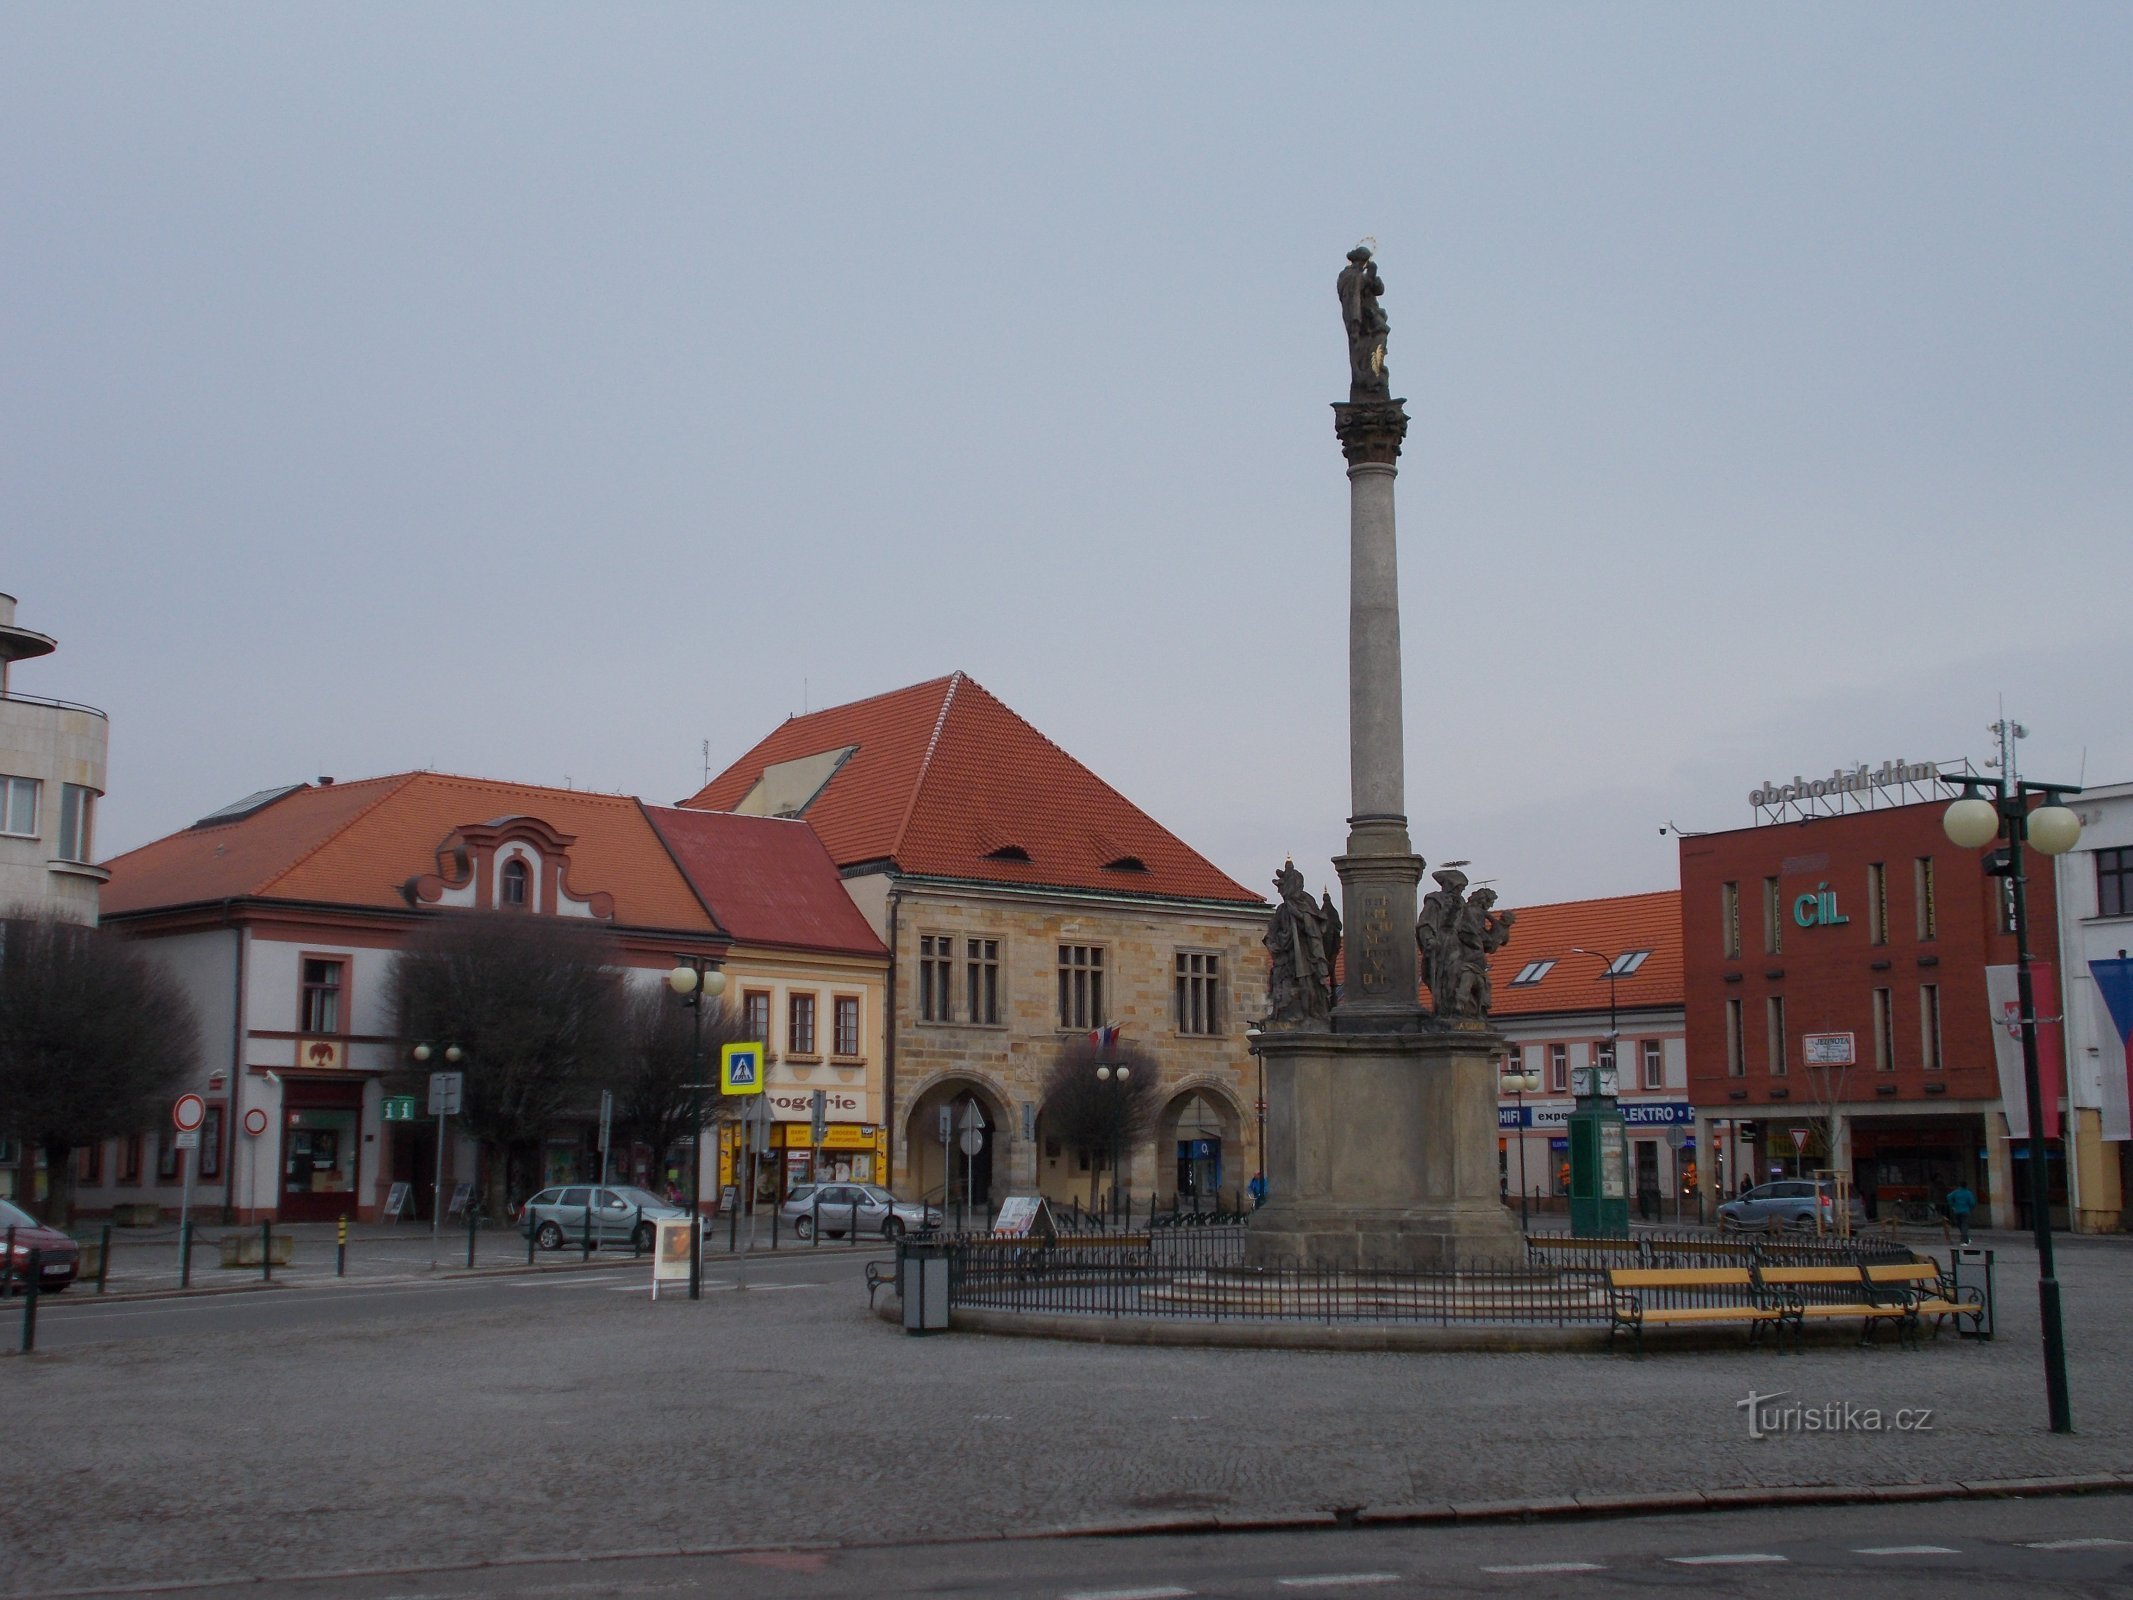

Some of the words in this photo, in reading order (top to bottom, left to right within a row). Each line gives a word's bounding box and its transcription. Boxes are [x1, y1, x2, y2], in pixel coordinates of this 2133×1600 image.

[1749, 764, 1869, 807] obchodní
[1874, 759, 1937, 787] dům
[1538, 1112, 1569, 1122] expe
[1617, 1106, 1675, 1122] LEKTRO
